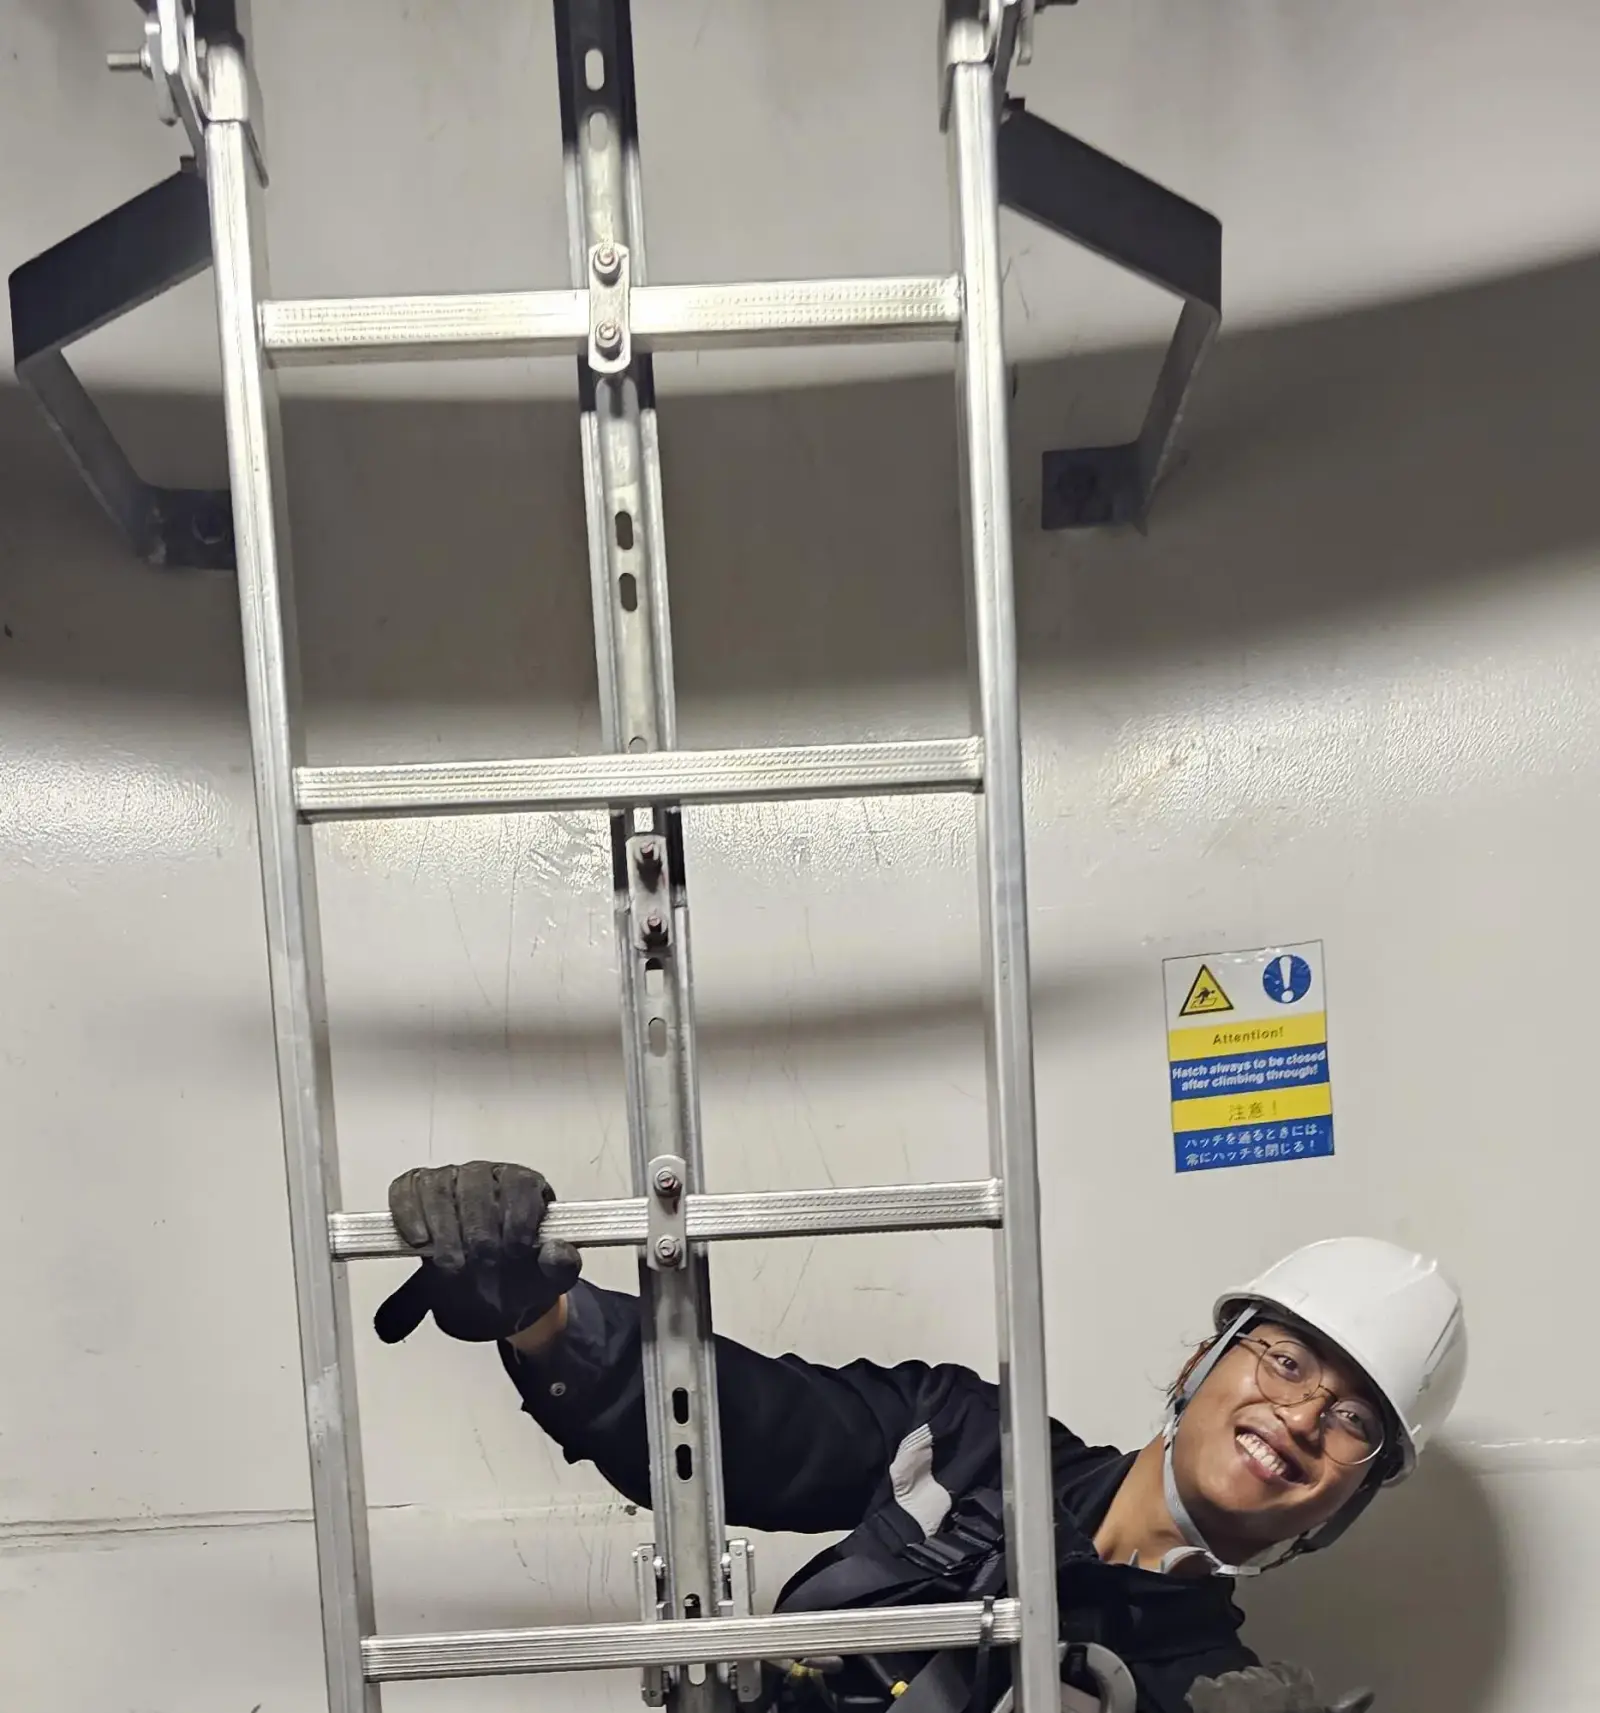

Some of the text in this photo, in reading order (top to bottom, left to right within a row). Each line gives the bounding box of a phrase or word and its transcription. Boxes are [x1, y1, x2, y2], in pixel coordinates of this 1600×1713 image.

[1212, 1026, 1284, 1045] Attention!
[1172, 1050, 1326, 1079] Hatch always to be closed
[1181, 1064, 1318, 1092] after climbing through!
